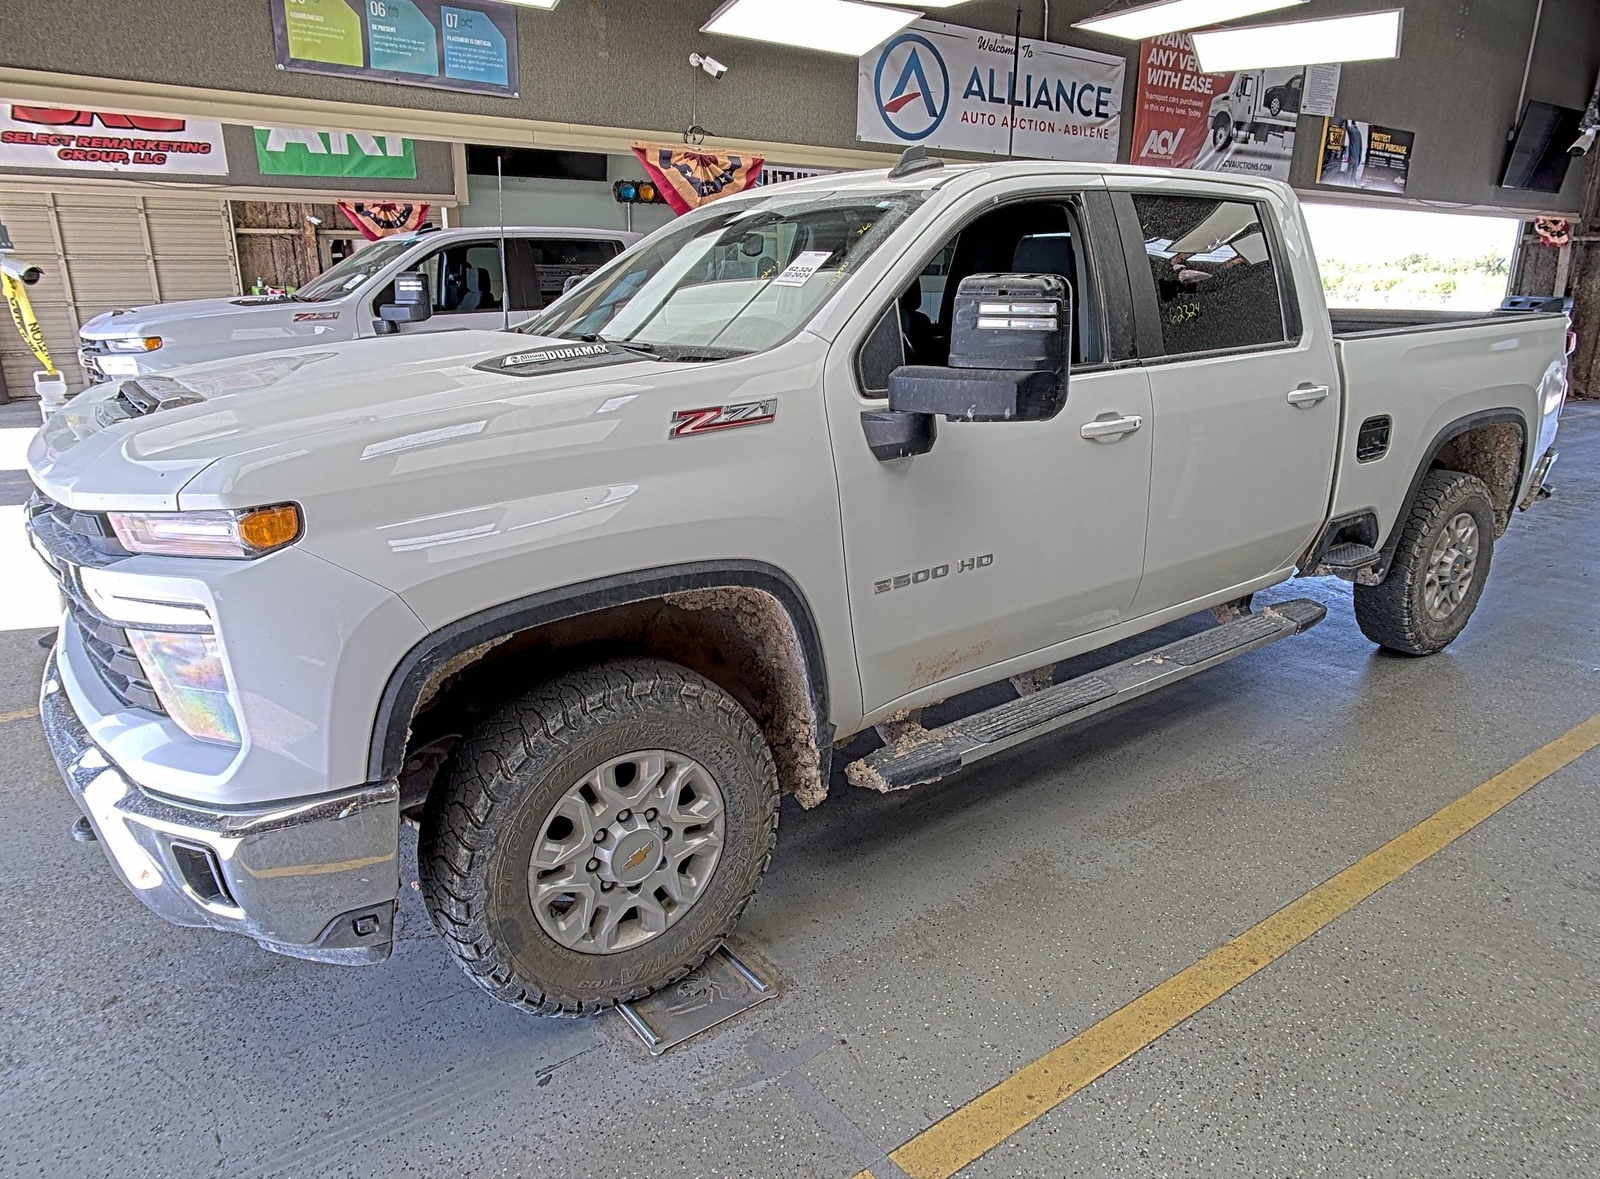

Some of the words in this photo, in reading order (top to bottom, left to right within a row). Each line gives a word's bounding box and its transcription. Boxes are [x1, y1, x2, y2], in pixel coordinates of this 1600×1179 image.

[370, 1, 386, 17] 06
[378, 24, 397, 33] PRESENT
[446, 13, 458, 28] 07
[447, 35, 469, 44] PLACEMENT
[474, 39, 492, 47] CRITICAL
[1021, 44, 1033, 58] To
[1146, 47, 1178, 68] ANY
[1147, 67, 1181, 90] WITH
[1181, 74, 1214, 95] EASE.
[962, 65, 1112, 119] ALLIANCE
[1145, 91, 1168, 102] Transport
[1169, 96, 1179, 104] cars
[1180, 98, 1204, 108] purchased
[1144, 102, 1149, 110] in
[1150, 103, 1159, 111] this
[1166, 106, 1175, 115] any
[1175, 106, 1187, 115] lane.
[961, 110, 996, 126] AUTO
[1001, 115, 1055, 134] AUCTION
[1063, 124, 1110, 140] ABILENE
[1, 131, 75, 147] SELECT
[76, 135, 212, 154] REMARKETING
[1140, 128, 1185, 157] ACV
[1370, 140, 1385, 150] EVERY
[1371, 132, 1391, 143] PROTECT
[58, 148, 130, 165] GROUP,
[133, 151, 167, 165] LLC
[293, 311, 340, 322] Z71
[549, 344, 610, 361] DURAMAX
[668, 398, 778, 440] Z71
[874, 563, 949, 595] 2500
[957, 553, 993, 574] HD
[620, 953, 670, 986] T/A
